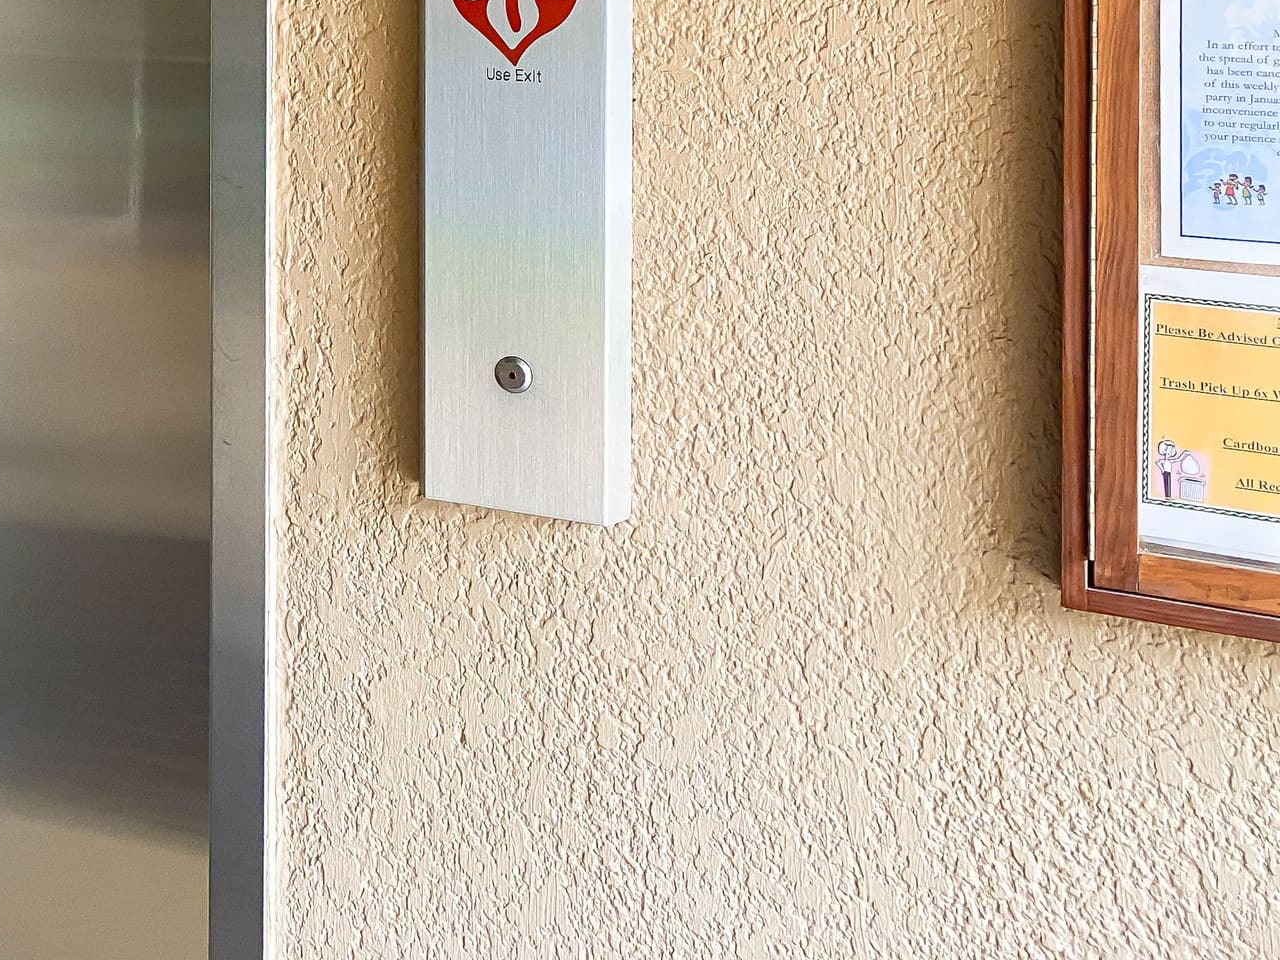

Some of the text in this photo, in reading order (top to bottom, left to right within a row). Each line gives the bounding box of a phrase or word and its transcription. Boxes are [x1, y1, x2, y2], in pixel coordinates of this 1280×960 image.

[1207, 40, 1218, 49] In
[1238, 41, 1269, 51] effort
[1199, 52, 1215, 62] the
[1219, 54, 1253, 65] spread
[1256, 55, 1270, 64] of
[486, 67, 541, 83] Use Exit
[1207, 65, 1224, 75] has
[1227, 66, 1253, 77] been
[1204, 79, 1279, 93] of this weekly
[1205, 94, 1233, 104] party
[1202, 106, 1279, 117] inconvenience
[1218, 120, 1237, 128] our
[1204, 133, 1276, 144] your patience
[1156, 323, 1194, 337] Please
[1198, 328, 1214, 339] Be
[1217, 331, 1267, 345] Advised
[1159, 376, 1195, 390] Trash
[1200, 381, 1227, 394] Pick
[1232, 385, 1250, 398] Up
[1254, 388, 1268, 399] 6x
[1235, 478, 1254, 488] All
